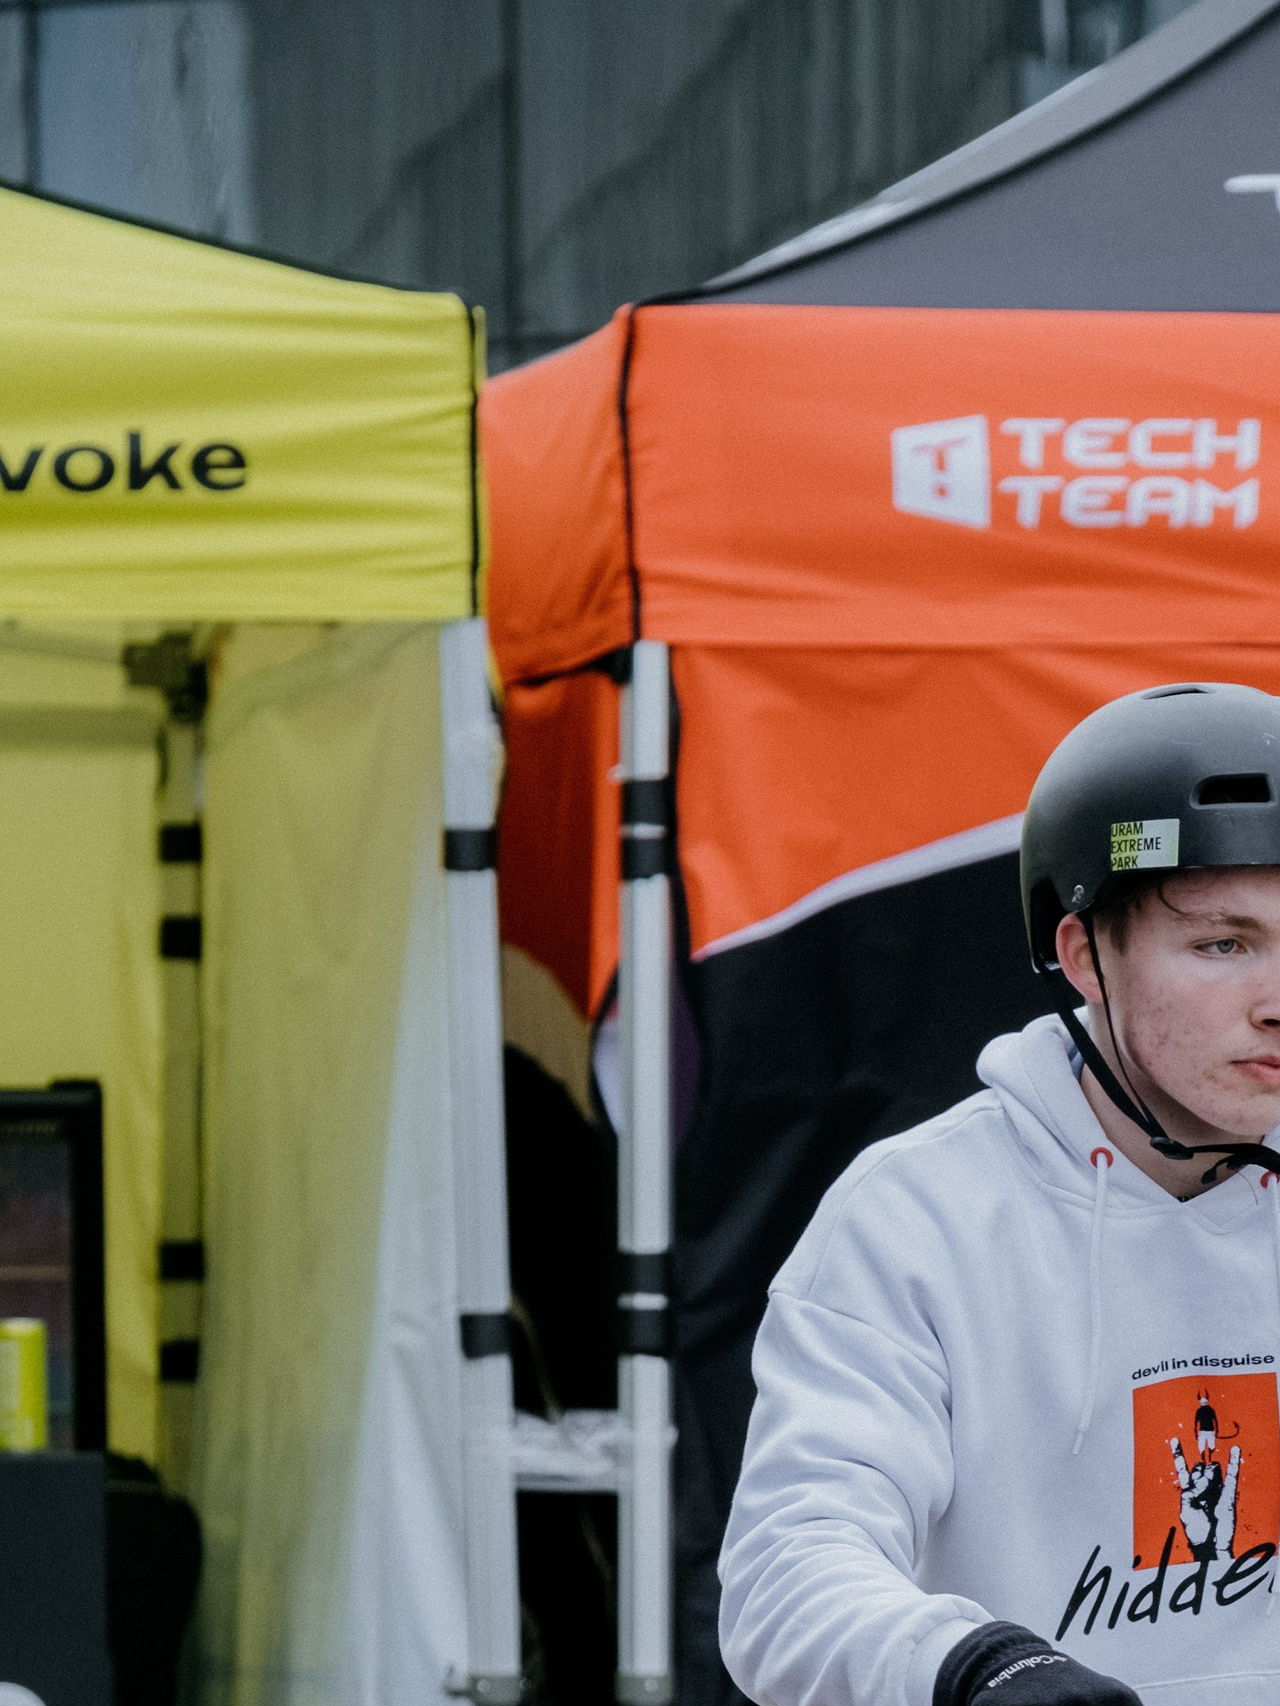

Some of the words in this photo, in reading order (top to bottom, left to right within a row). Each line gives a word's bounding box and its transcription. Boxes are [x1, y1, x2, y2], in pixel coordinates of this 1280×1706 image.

[1000, 417, 1262, 471] TECH
[0, 431, 246, 492] voke
[997, 475, 1260, 530] TEAM
[1111, 837, 1162, 854] EXTREME
[1112, 855, 1139, 869] PARK
[1131, 1359, 1169, 1380] devil
[1172, 1357, 1188, 1370] in
[1191, 1353, 1275, 1369] disguise
[987, 1655, 1055, 1688] Columbia
